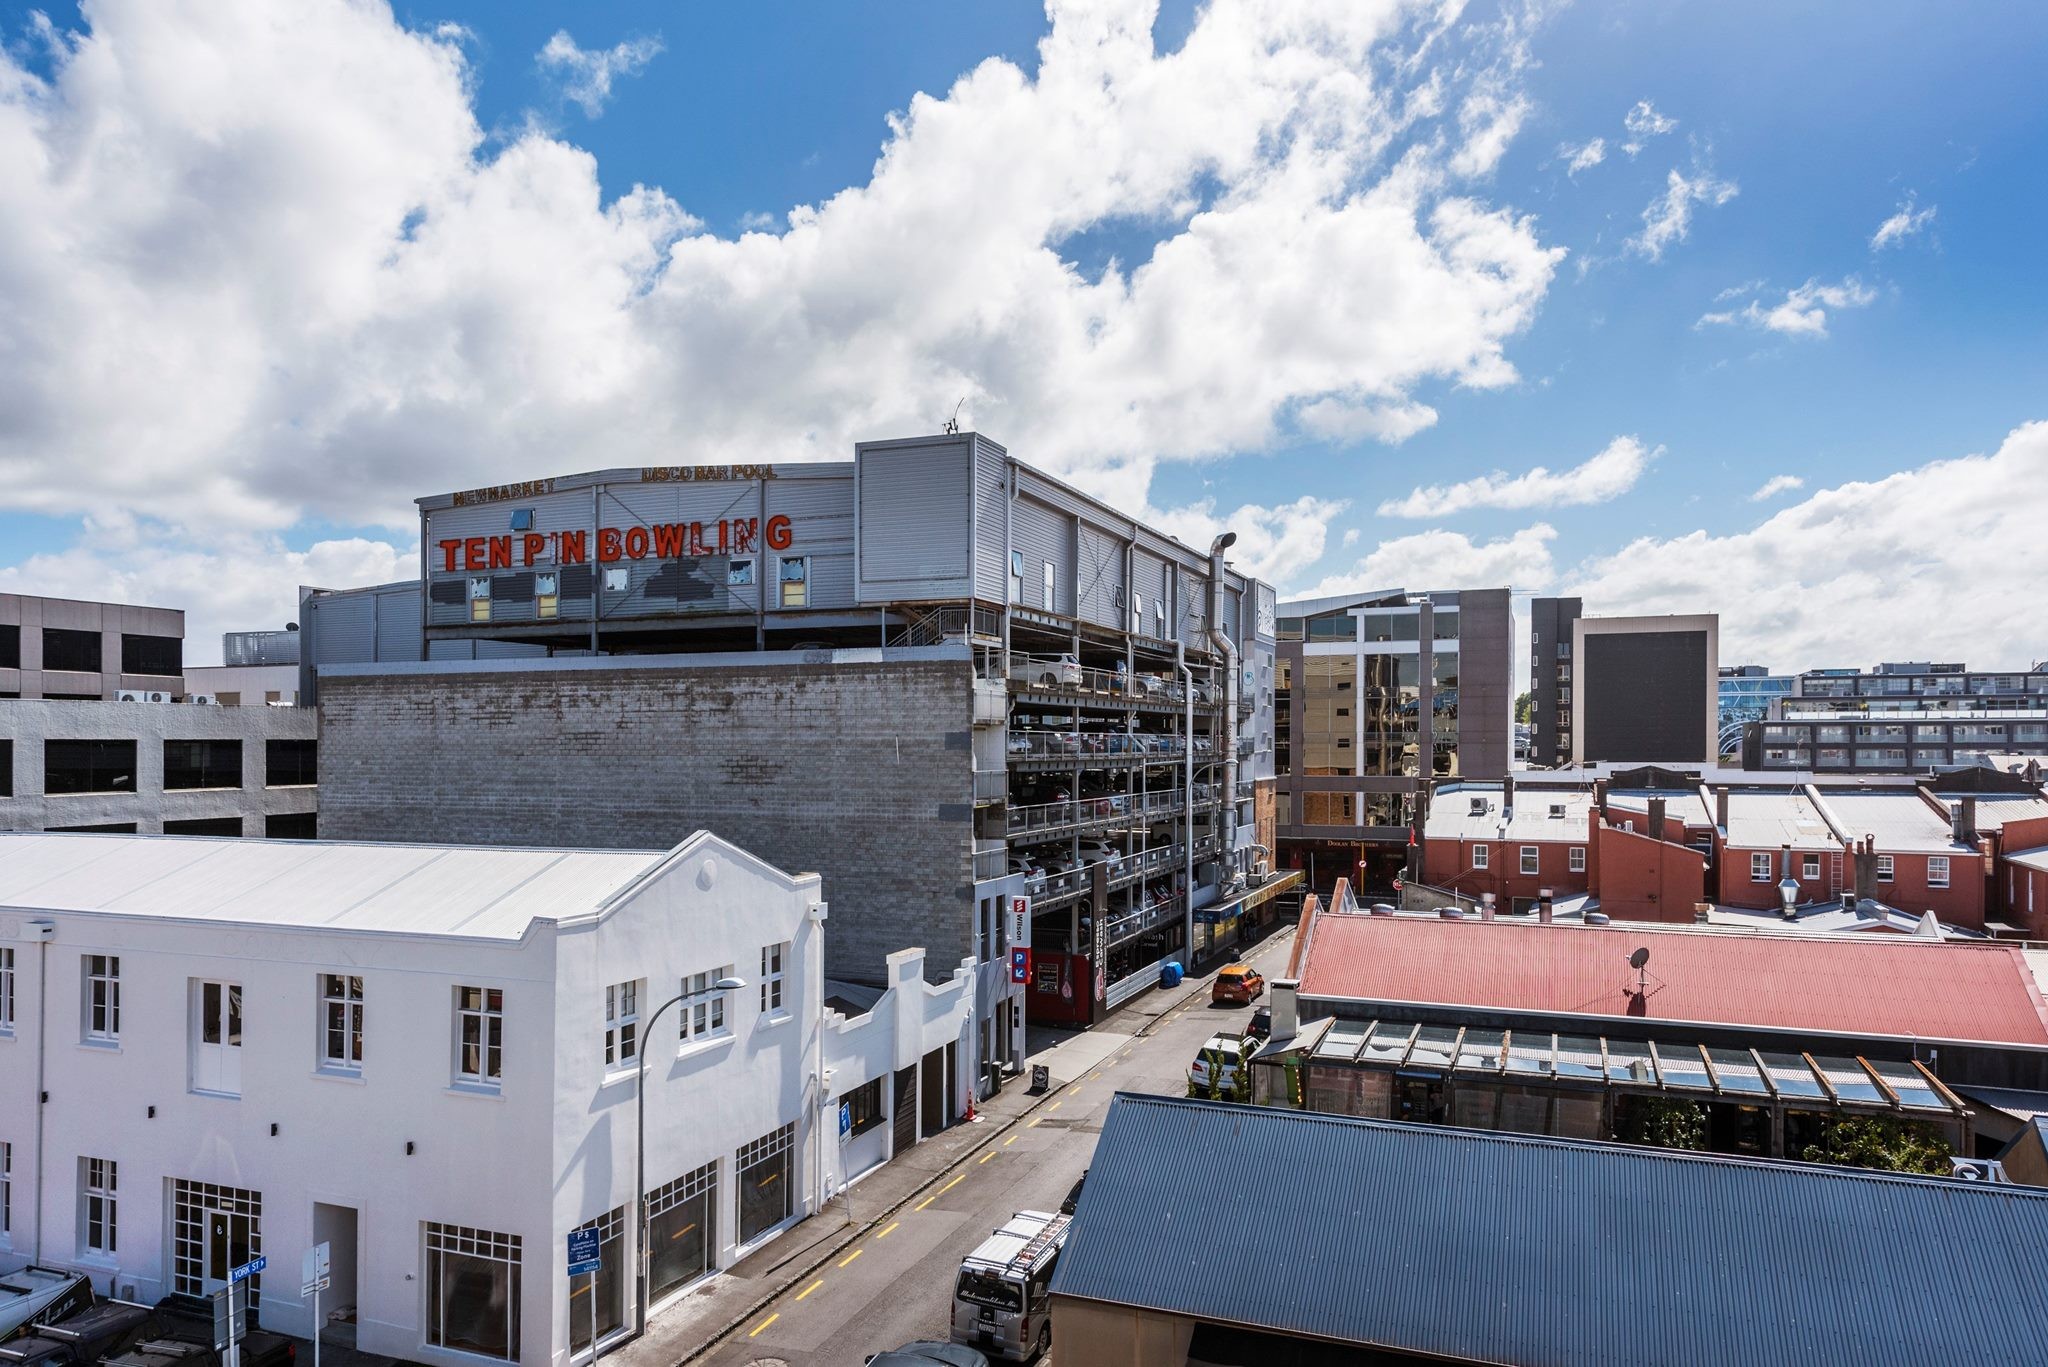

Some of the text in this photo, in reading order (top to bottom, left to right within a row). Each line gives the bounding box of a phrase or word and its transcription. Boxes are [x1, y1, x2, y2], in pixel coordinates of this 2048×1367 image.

[641, 464, 778, 481] DISCO BAR POOL
[453, 478, 556, 506] NEWMARKET
[439, 515, 792, 572] TEN PIN BOWLING
[1016, 914, 1024, 941] Wilson
[1016, 953, 1023, 962] P
[841, 1107, 847, 1120] P
[234, 1261, 260, 1279] YORK ST
